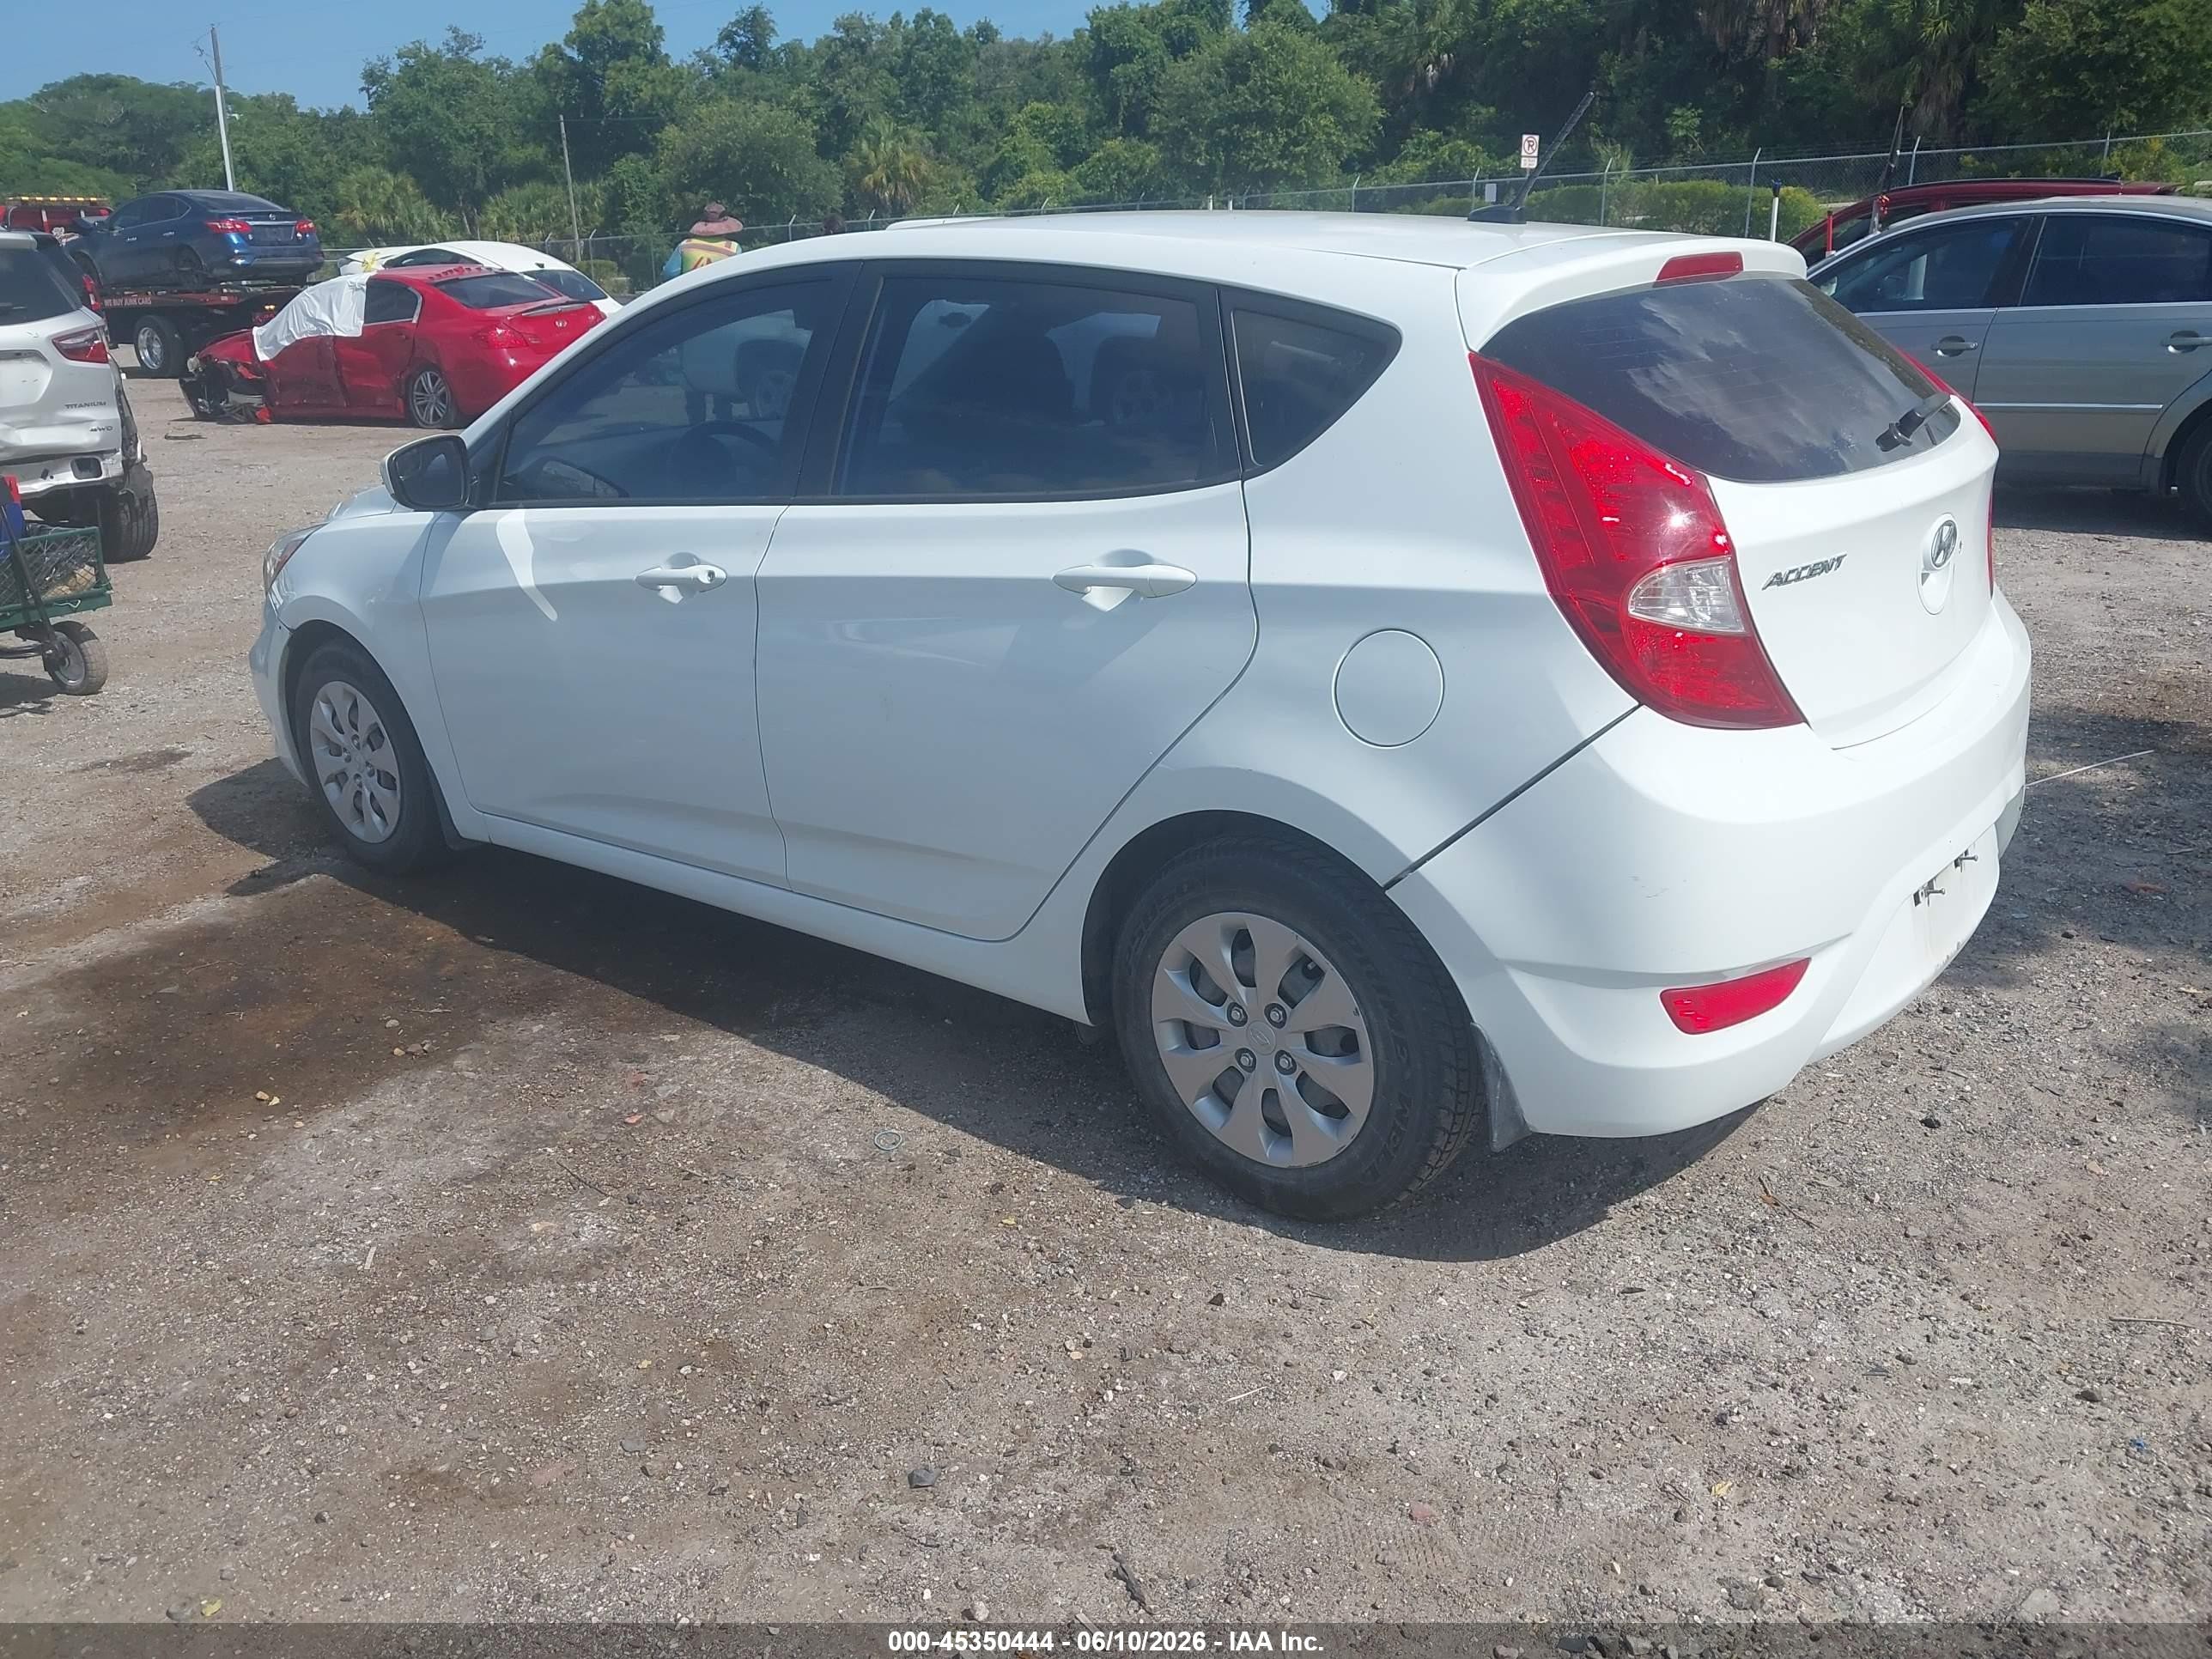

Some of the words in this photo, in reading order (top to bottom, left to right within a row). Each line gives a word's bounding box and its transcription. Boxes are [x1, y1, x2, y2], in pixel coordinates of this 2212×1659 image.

[112, 298, 124, 307] BUY
[64, 401, 107, 410] TITANIUM
[1761, 553, 1847, 591] ACCENT
